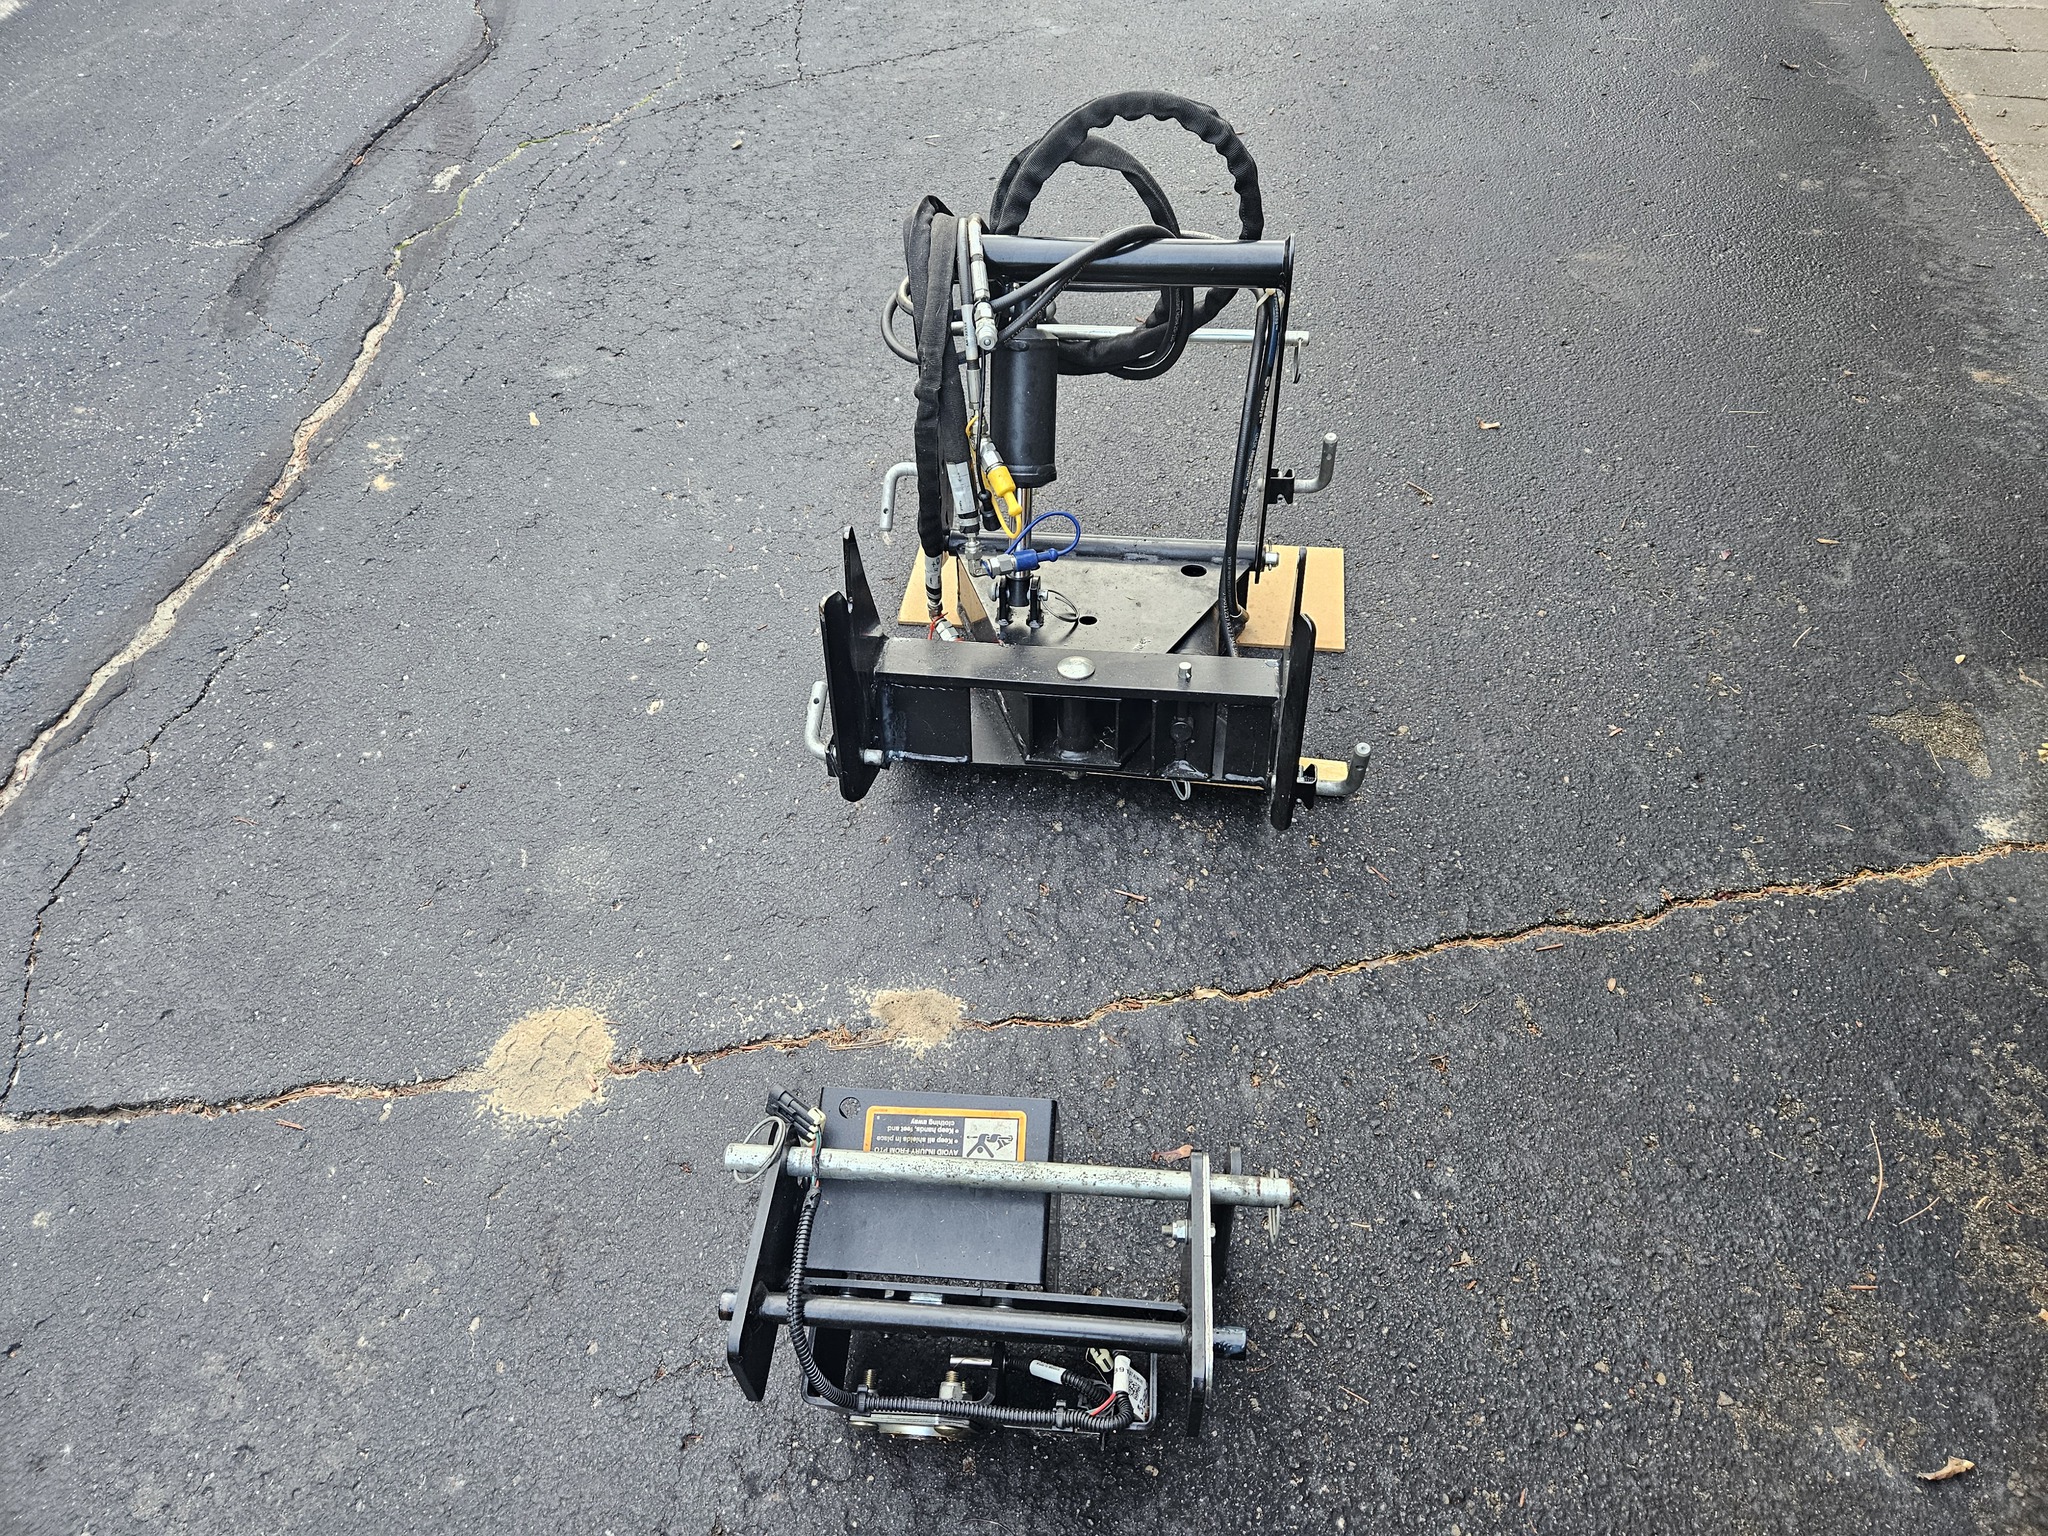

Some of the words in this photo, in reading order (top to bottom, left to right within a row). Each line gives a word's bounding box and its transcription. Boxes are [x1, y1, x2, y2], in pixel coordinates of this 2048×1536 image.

[910, 1117, 928, 1125] away
[928, 1118, 955, 1126] clothing
[914, 1126, 937, 1134] hands,
[937, 1126, 954, 1134] Keep
[936, 1136, 953, 1144] Keep
